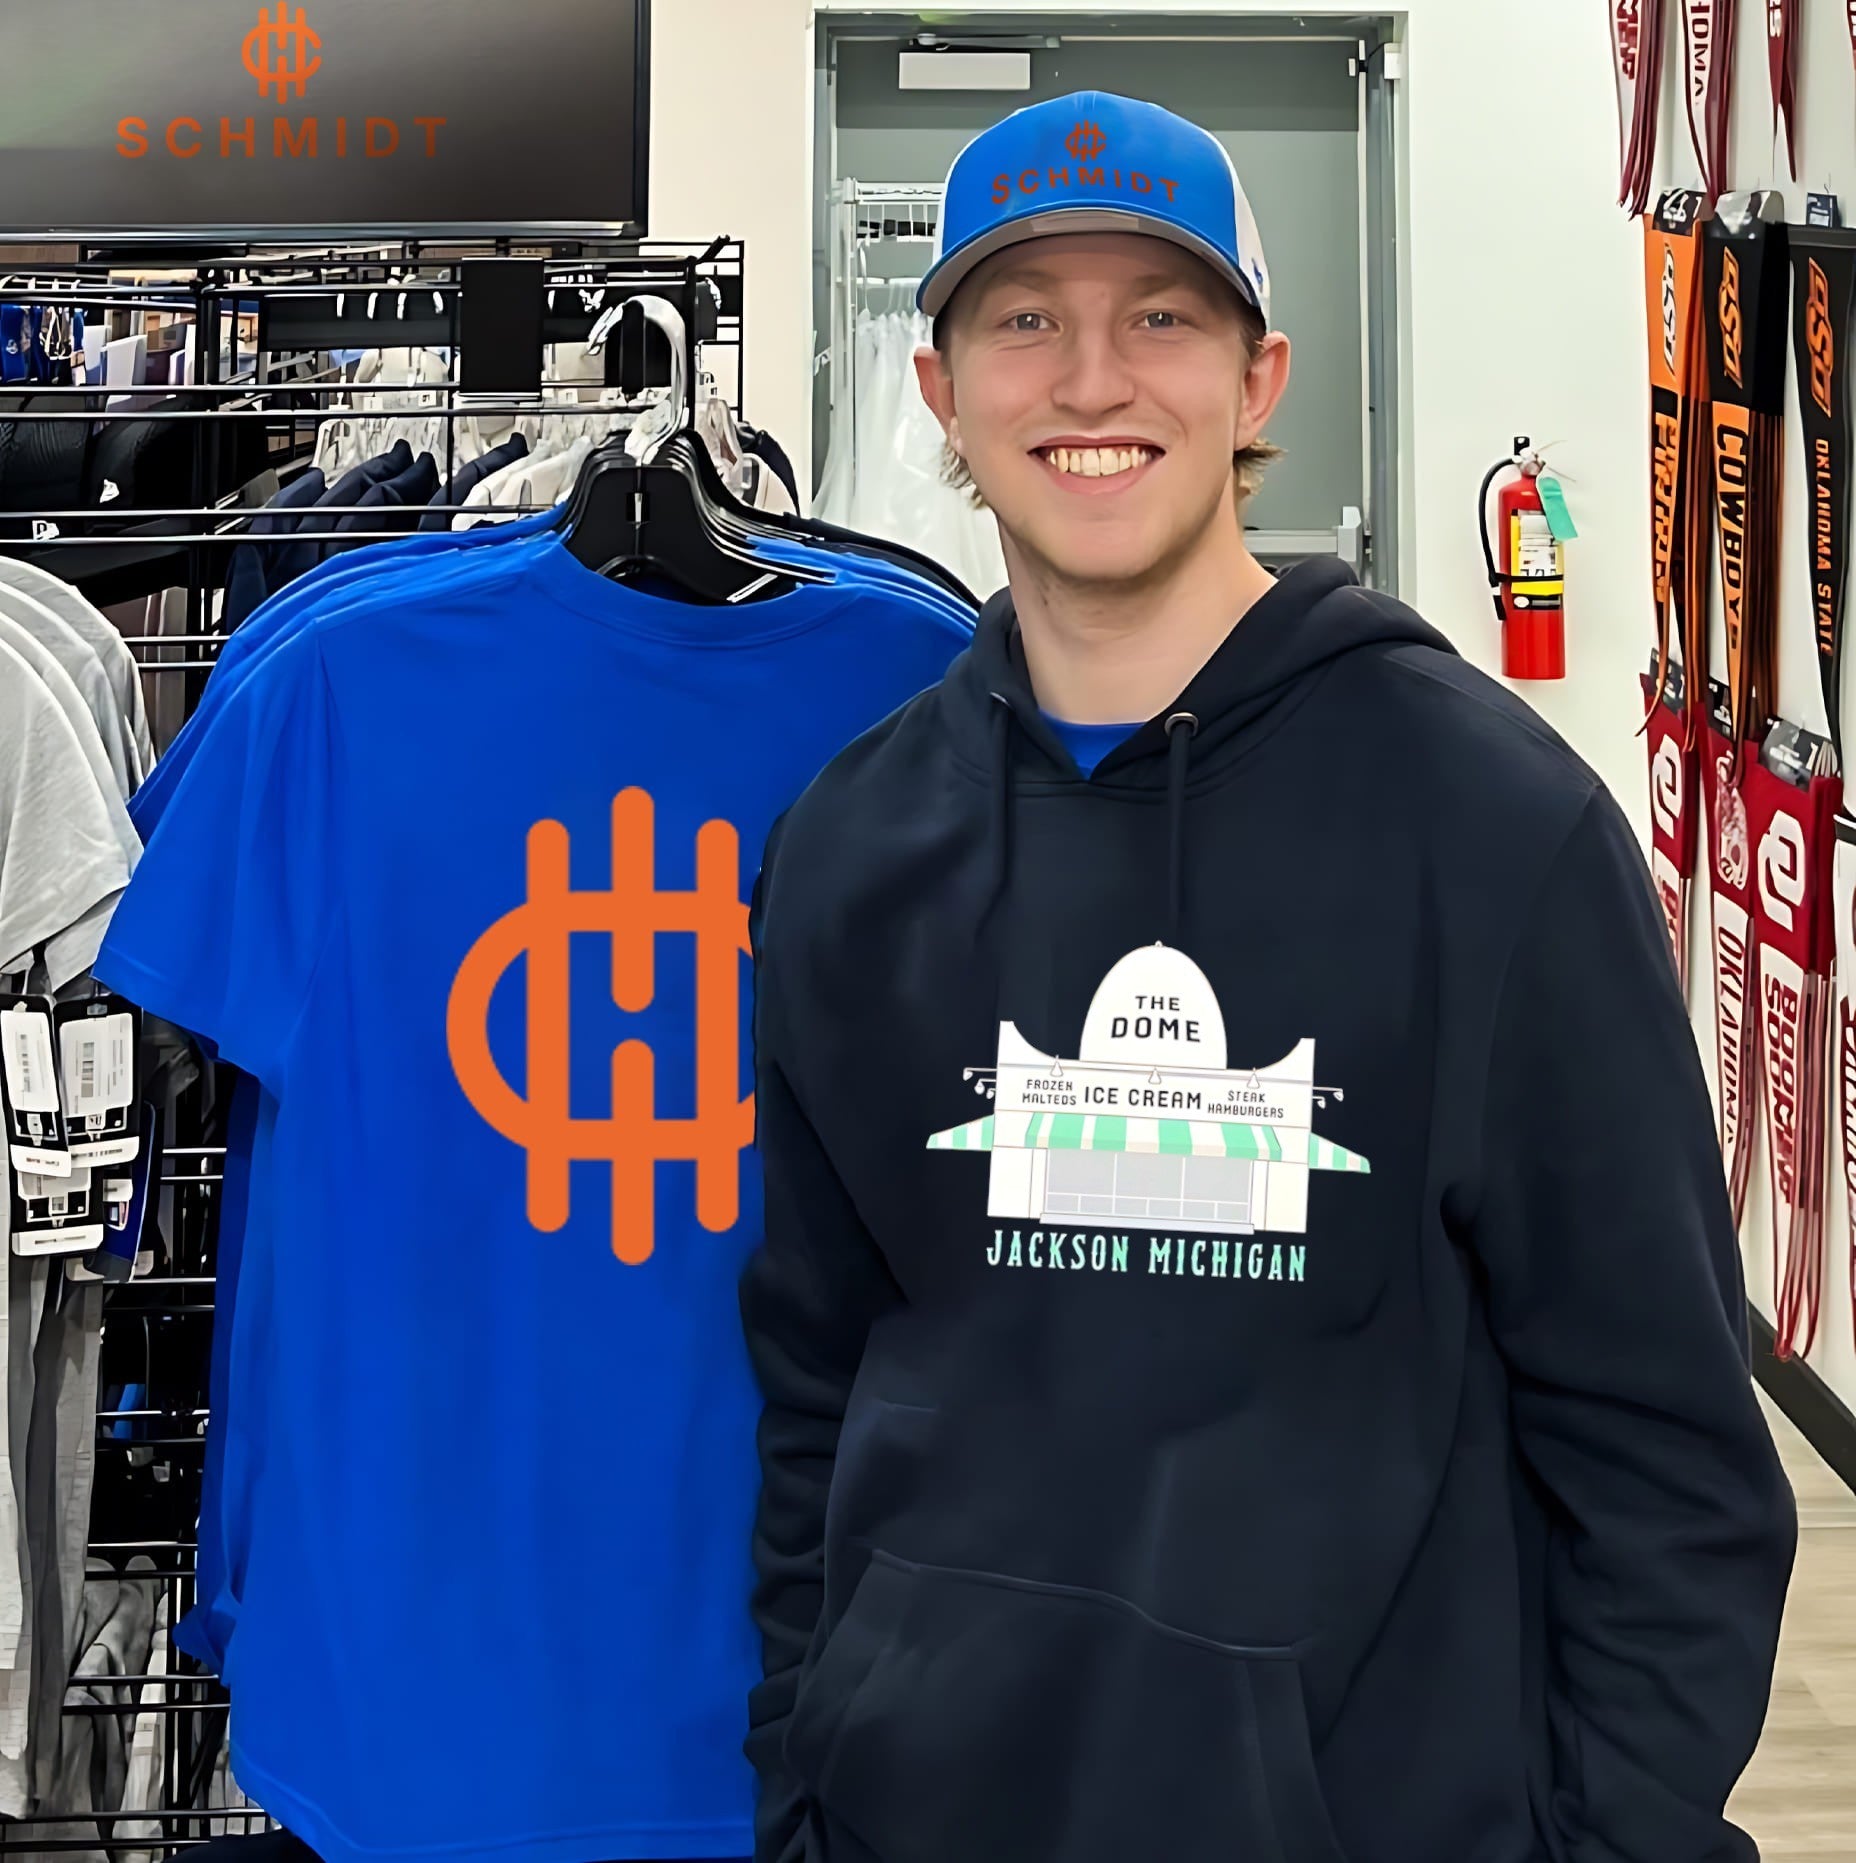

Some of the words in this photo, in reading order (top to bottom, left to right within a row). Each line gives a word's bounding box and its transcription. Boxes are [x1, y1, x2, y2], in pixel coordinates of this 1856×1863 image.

[115, 116, 448, 159] SCHMIDT
[991, 167, 1179, 205] SCHMIDT
[1815, 438, 1832, 570] OKLAHOMA
[1135, 995, 1181, 1012] THE
[1110, 1016, 1201, 1043] DOME
[1026, 1079, 1073, 1092] FROZEN
[1084, 1085, 1119, 1105] ICE
[1128, 1089, 1202, 1111] CREAM
[1227, 1090, 1266, 1103] STEAK
[1022, 1092, 1077, 1107] MALTEDS
[1207, 1103, 1285, 1119] HAMBURGERS
[986, 1229, 1129, 1273] JACKSON
[1148, 1236, 1307, 1282] MICHIGAN
